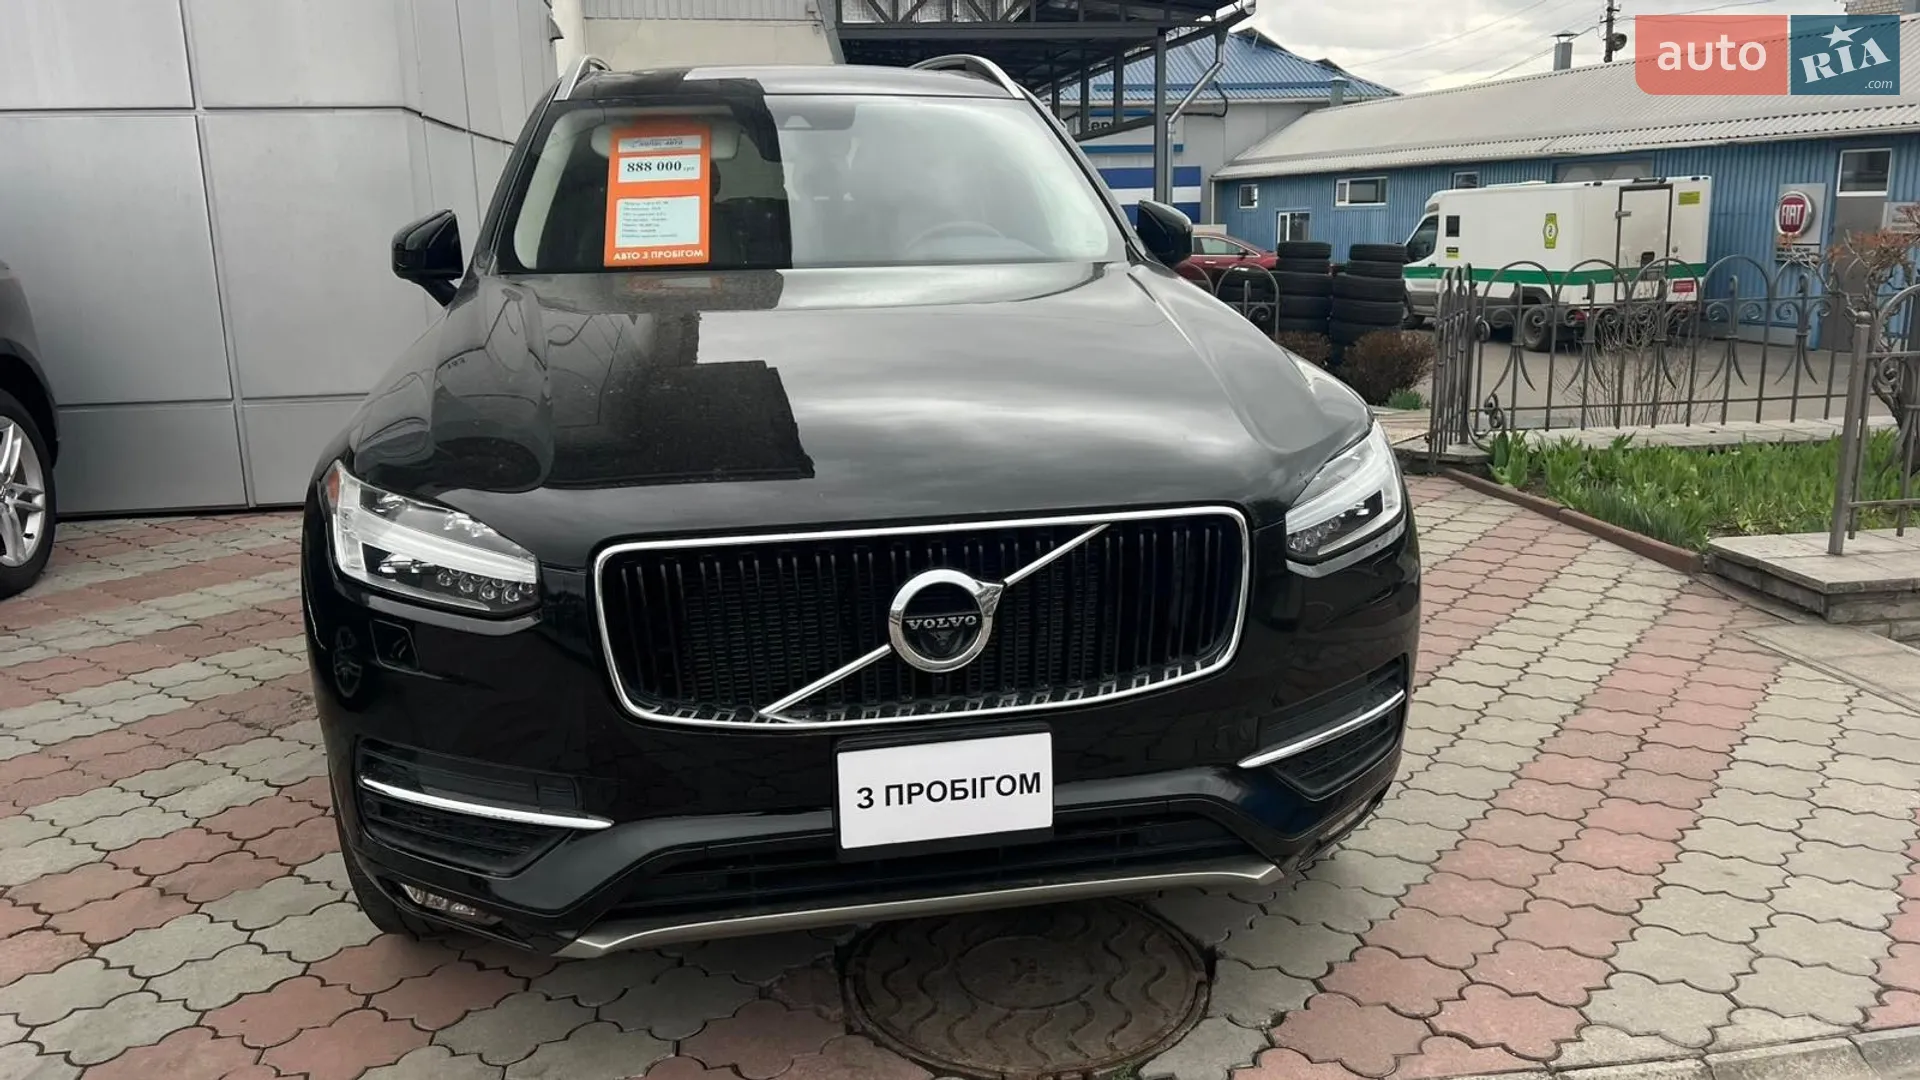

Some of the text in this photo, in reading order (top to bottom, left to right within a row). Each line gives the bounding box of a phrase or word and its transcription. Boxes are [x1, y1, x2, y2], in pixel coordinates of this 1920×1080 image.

[627, 161, 652, 172] 888
[656, 160, 682, 171] 000
[1781, 204, 1804, 225] FIAT
[614, 252, 640, 260] АВТО
[652, 249, 703, 258] ПРОБІГОМ
[906, 615, 977, 630] VOLVO
[856, 772, 1040, 809] З ПРОБІГОМ
